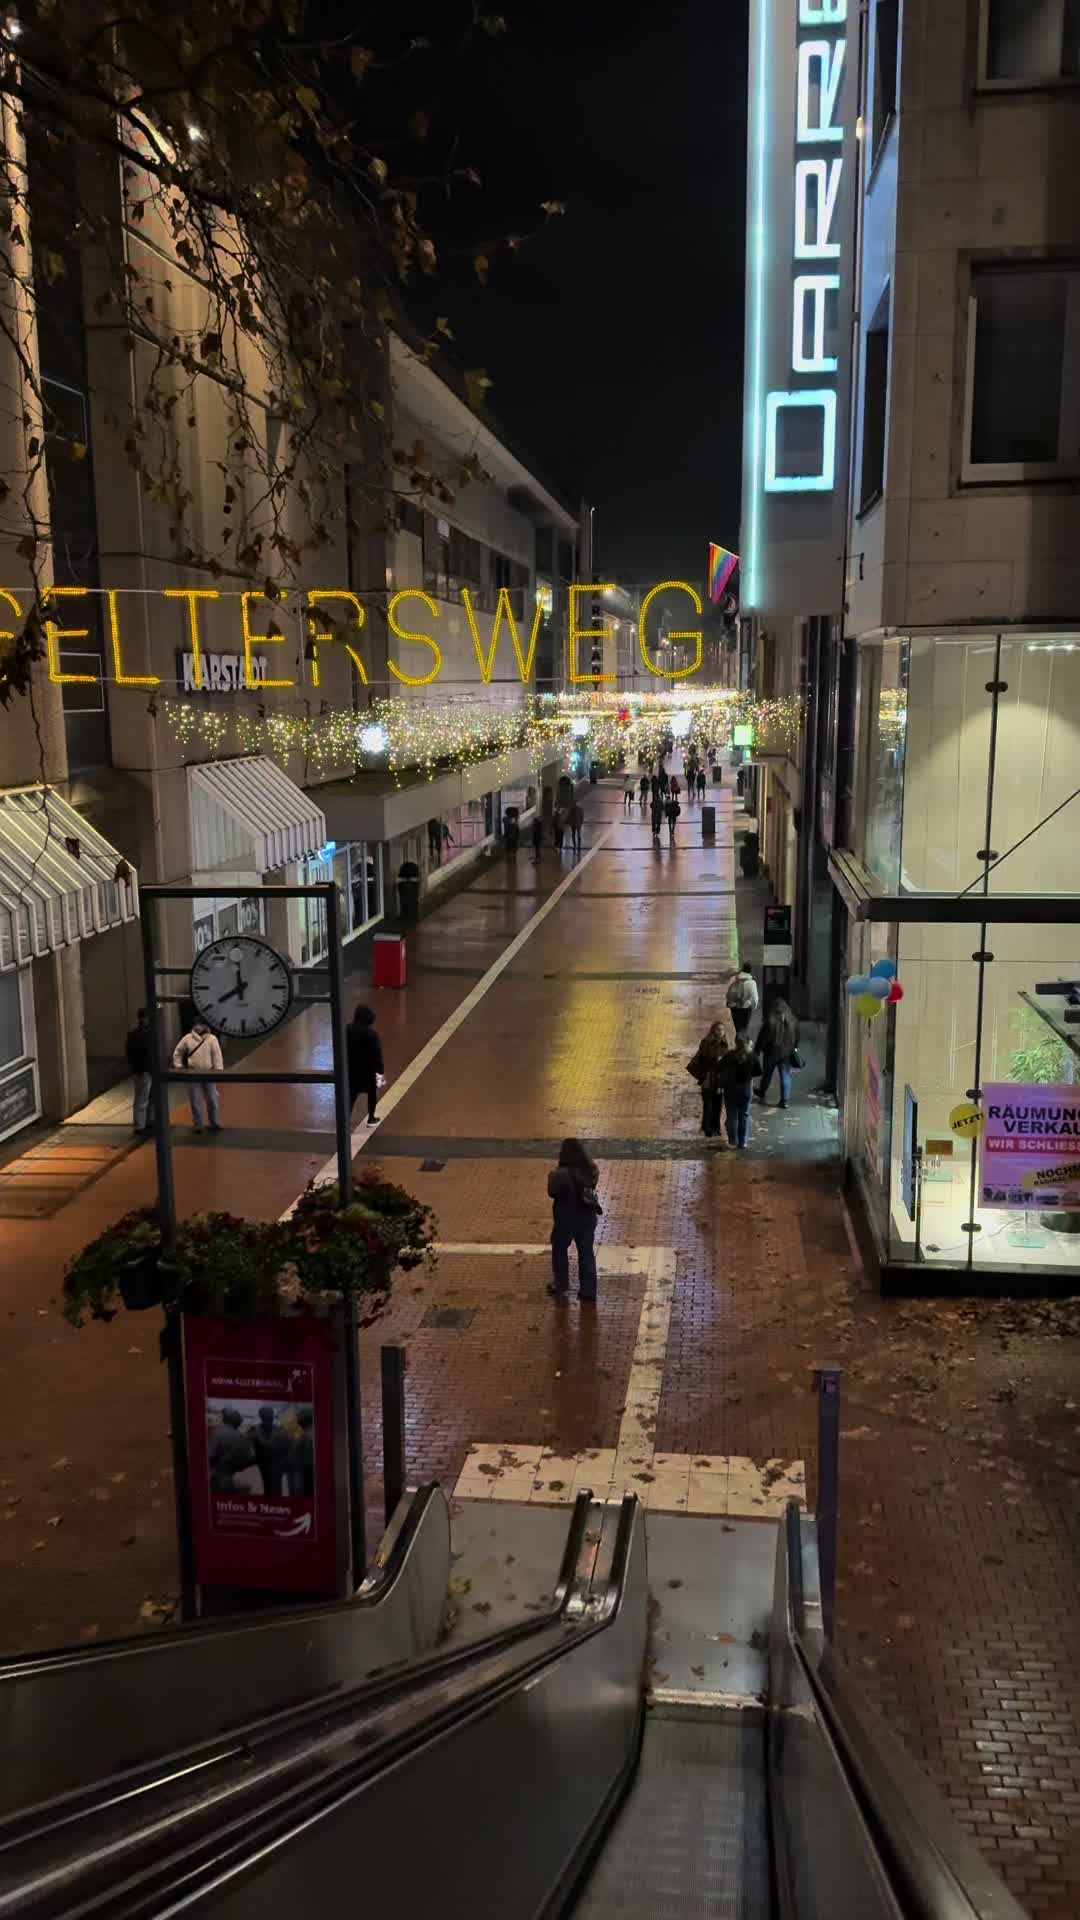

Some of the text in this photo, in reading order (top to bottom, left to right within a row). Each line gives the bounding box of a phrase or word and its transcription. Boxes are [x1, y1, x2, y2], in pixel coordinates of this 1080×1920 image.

[764, 0, 848, 492] DARR
[988, 1104, 1080, 1121] RÄUMUN
[988, 1139, 1014, 1149] WIR
[216, 1500, 245, 1513] Infos
[259, 1502, 291, 1515] News
